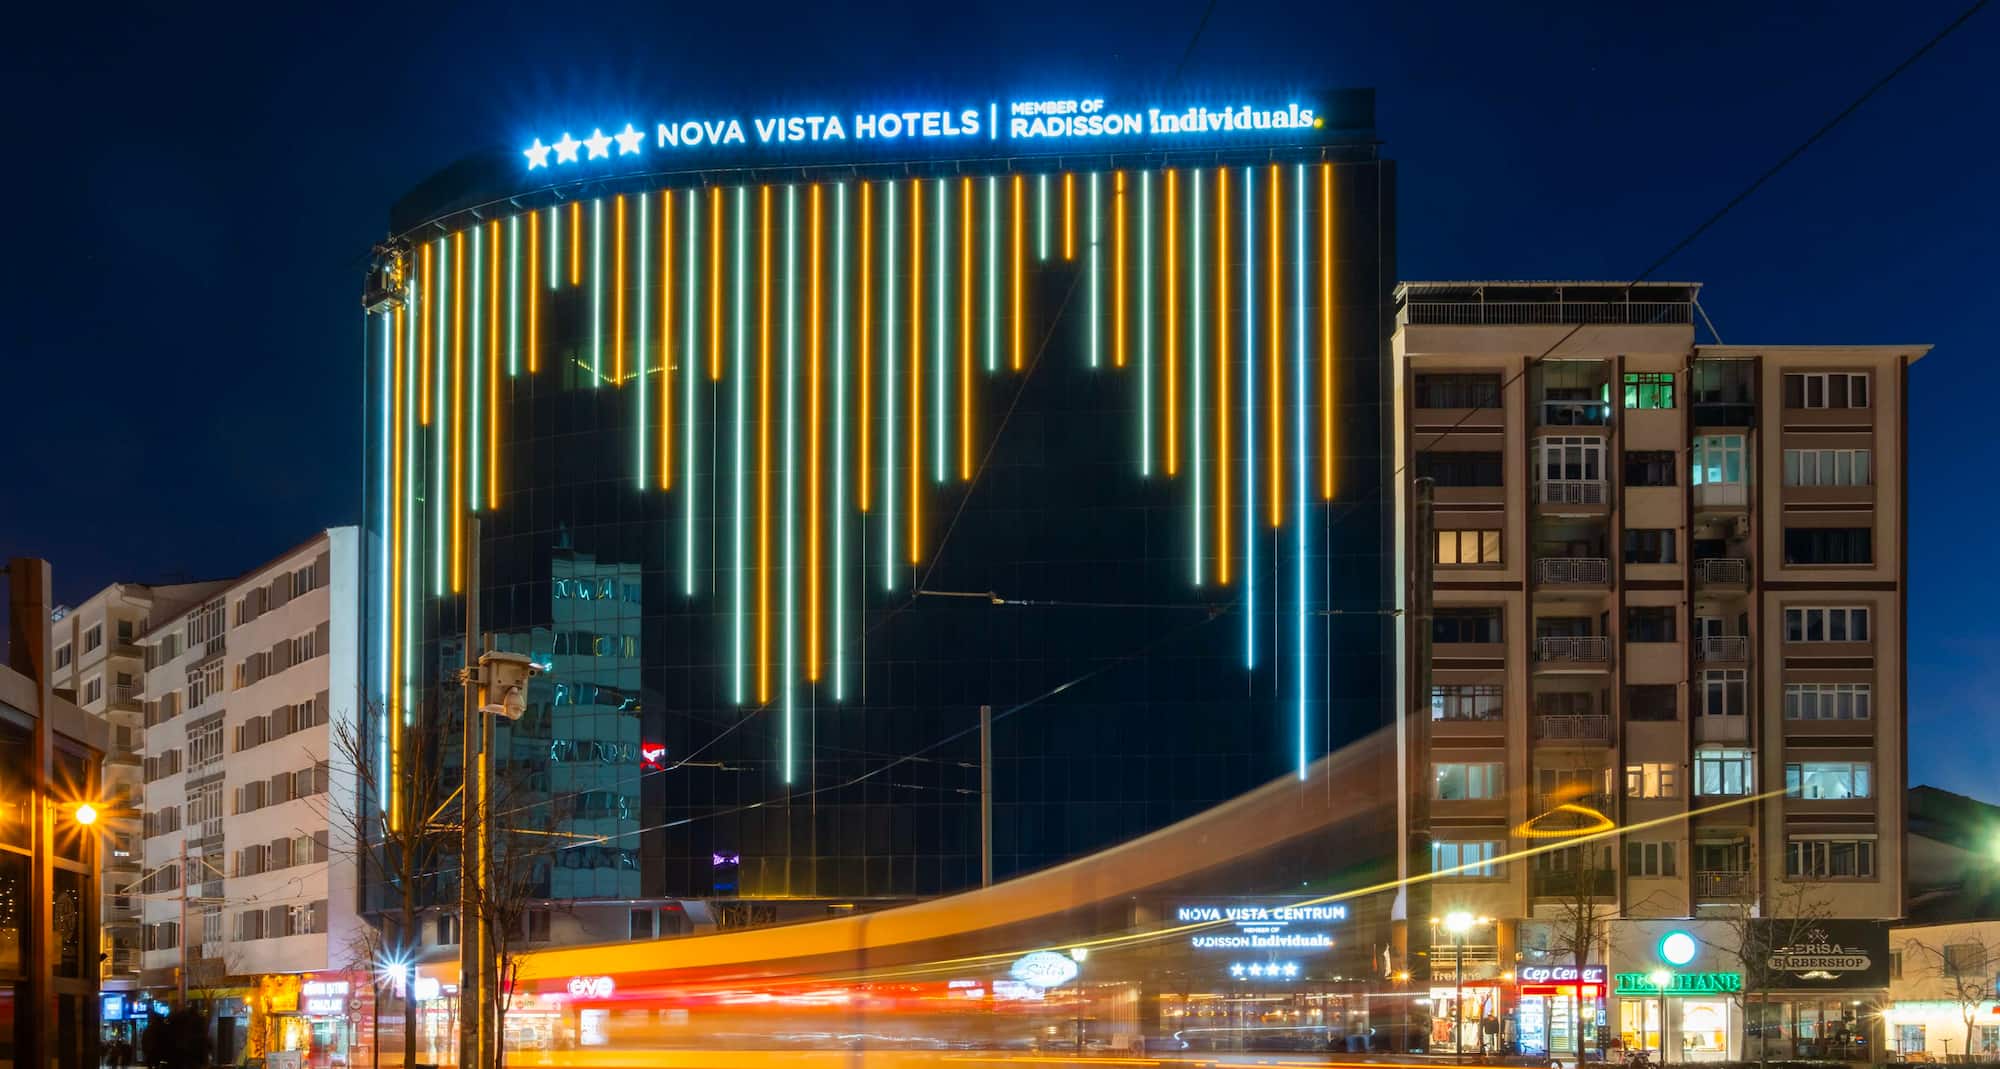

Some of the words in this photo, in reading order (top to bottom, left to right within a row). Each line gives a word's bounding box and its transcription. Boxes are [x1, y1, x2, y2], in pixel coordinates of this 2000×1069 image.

[1011, 101, 1077, 115] MEMBER
[1080, 99, 1104, 113] OF
[657, 120, 745, 148] NOVA
[755, 116, 845, 142] VISTA
[855, 110, 979, 139] HOTELS
[1011, 114, 1142, 138] RADISSON
[1179, 908, 1220, 921] NOVA
[1225, 908, 1268, 921] VISTA
[1273, 907, 1345, 920] CENTRUM
[1774, 958, 1863, 968] BARBERSHOP
[1522, 967, 1550, 982] Cep
[1551, 967, 1602, 980] Cener
